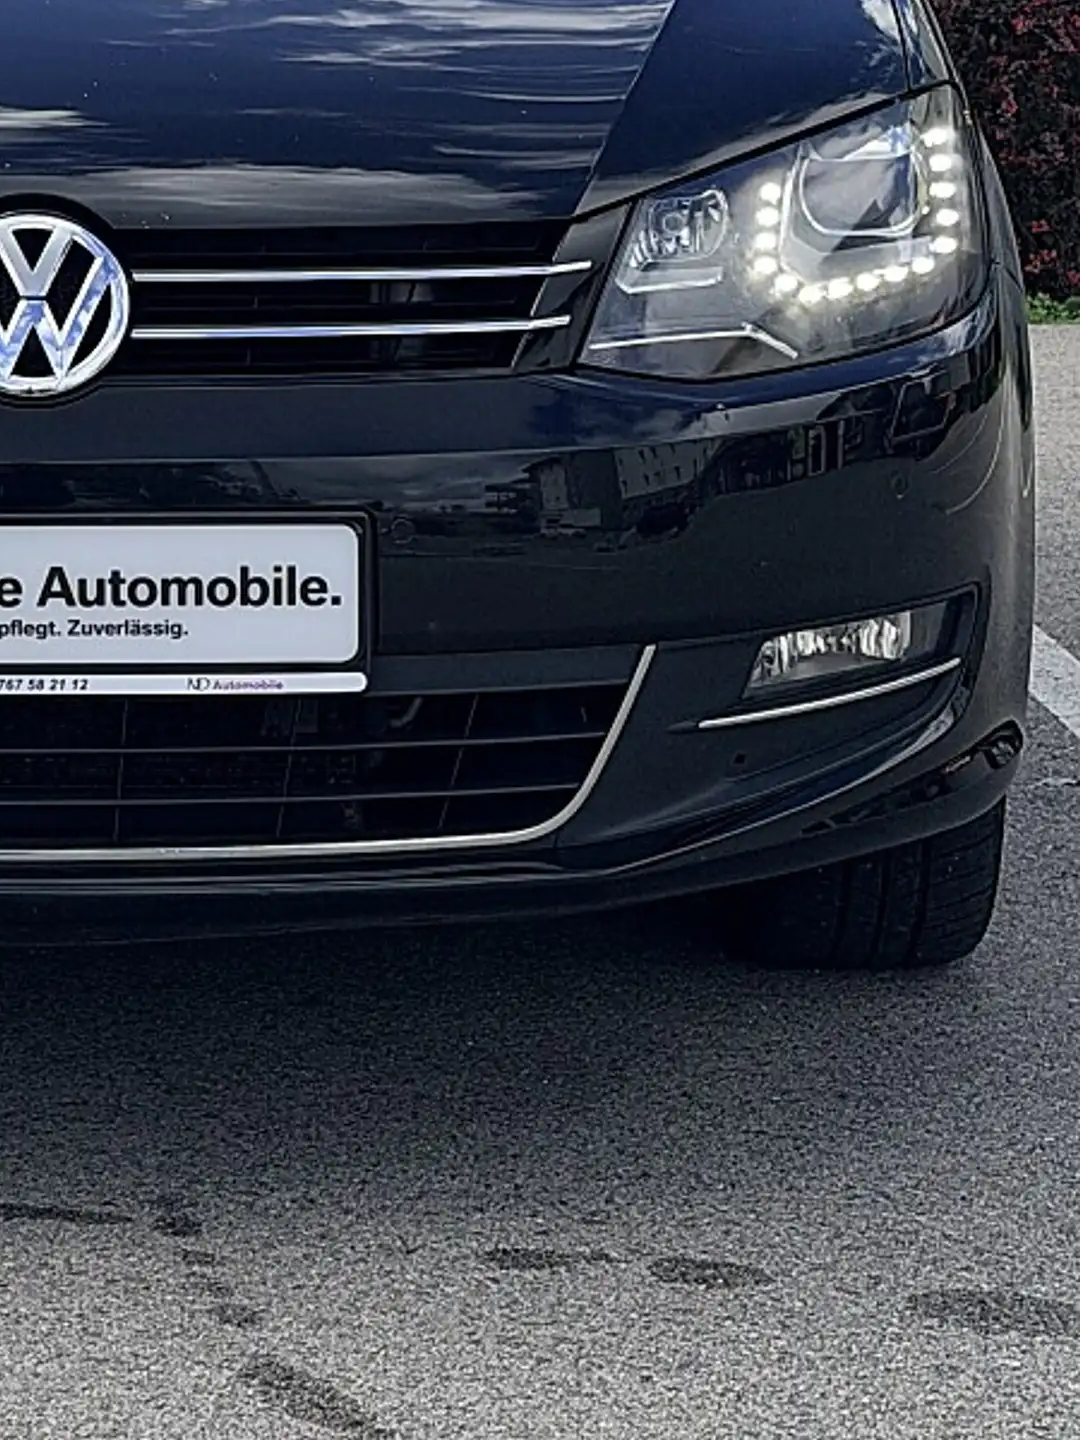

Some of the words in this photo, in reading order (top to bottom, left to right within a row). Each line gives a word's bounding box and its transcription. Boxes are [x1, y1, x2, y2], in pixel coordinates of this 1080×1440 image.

[36, 564, 343, 609] Automobile.
[67, 618, 189, 641] Zuverlässig.
[49, 678, 66, 691] 21
[72, 678, 88, 691] 12
